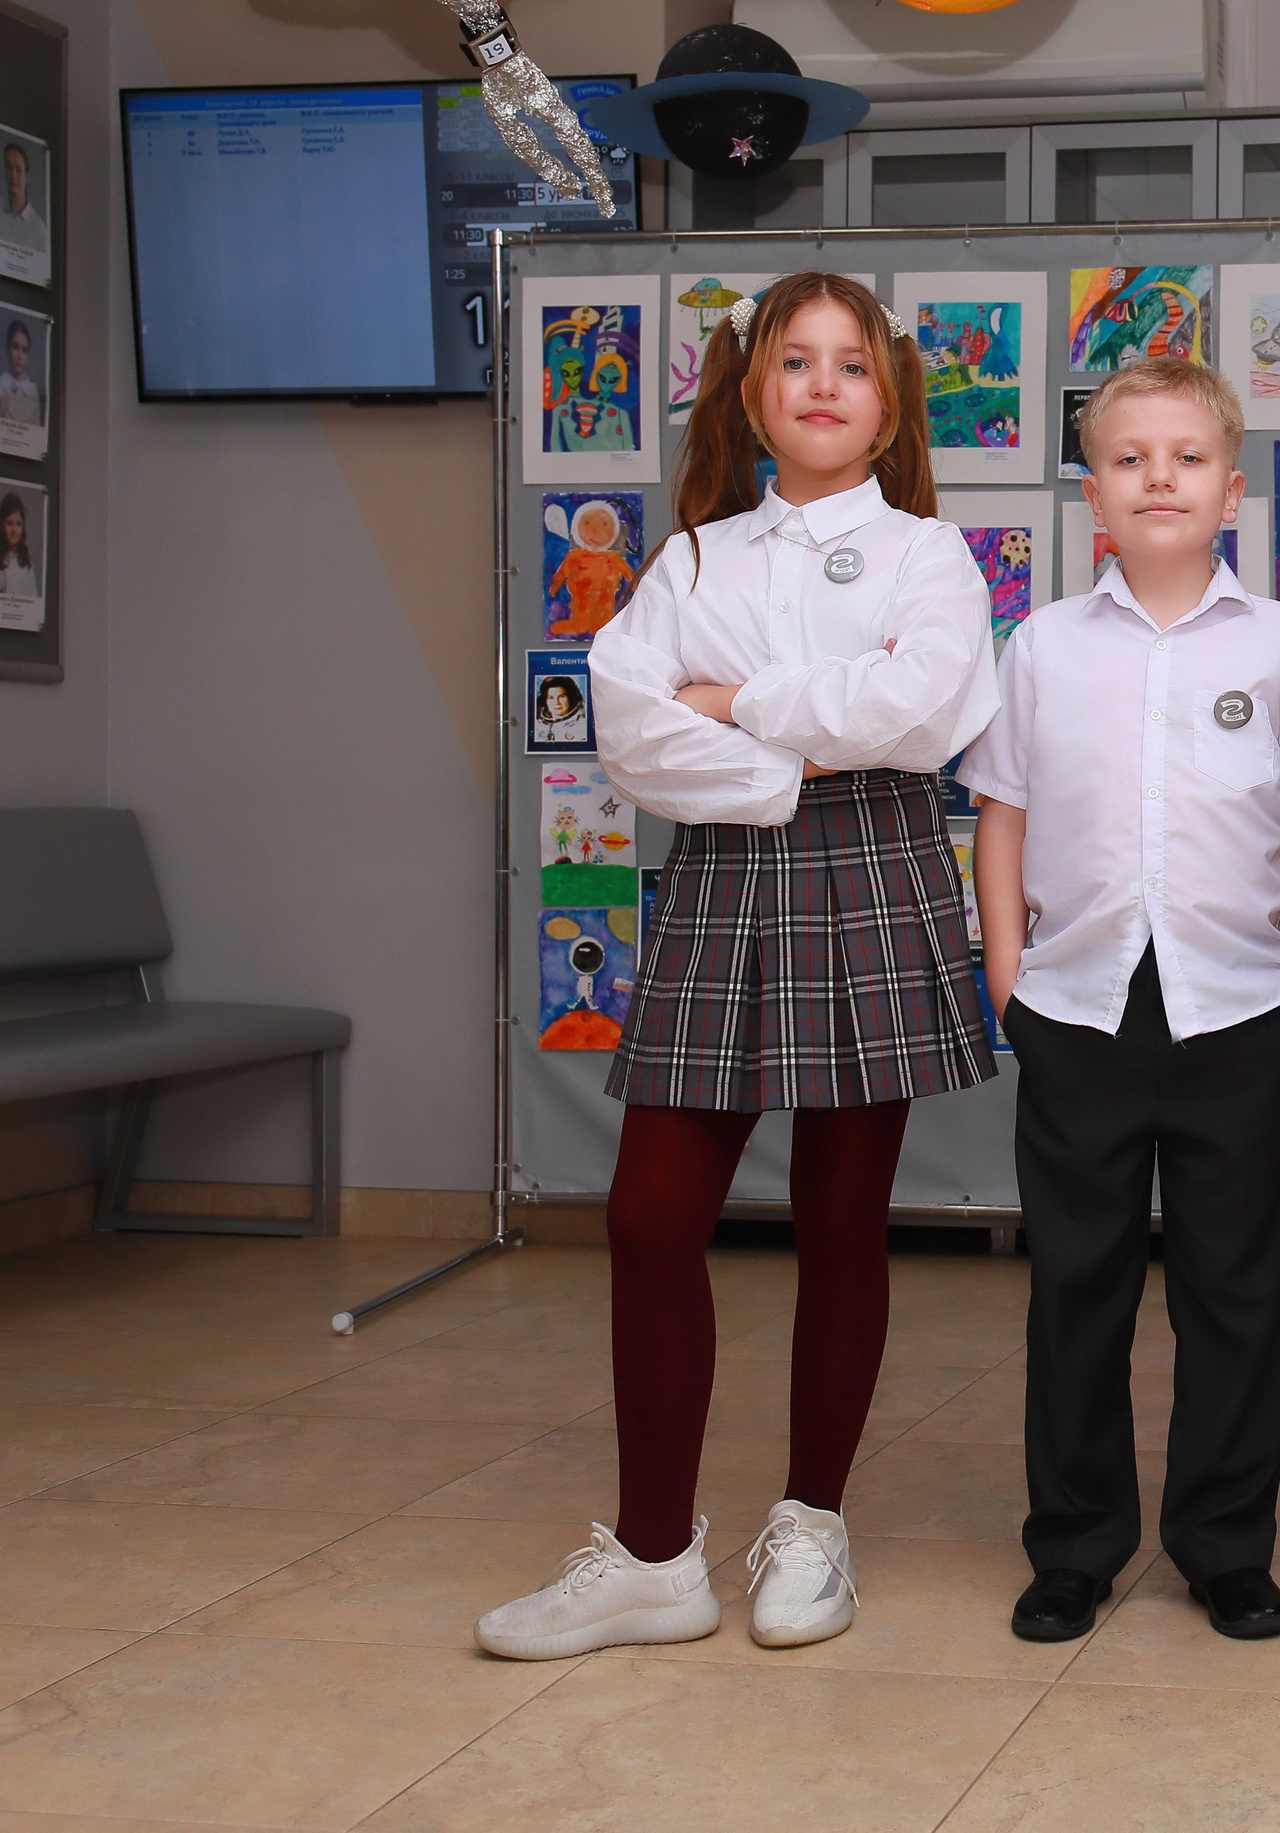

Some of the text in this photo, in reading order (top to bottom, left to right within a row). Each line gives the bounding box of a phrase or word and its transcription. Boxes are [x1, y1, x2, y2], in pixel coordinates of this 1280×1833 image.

[484, 42, 505, 59] 19
[577, 86, 617, 97] ГИМНАЗИ
[505, 189, 533, 199] 11:30
[537, 187, 545, 199] 5
[453, 229, 481, 240] 11:30
[550, 656, 588, 666] Валенти
